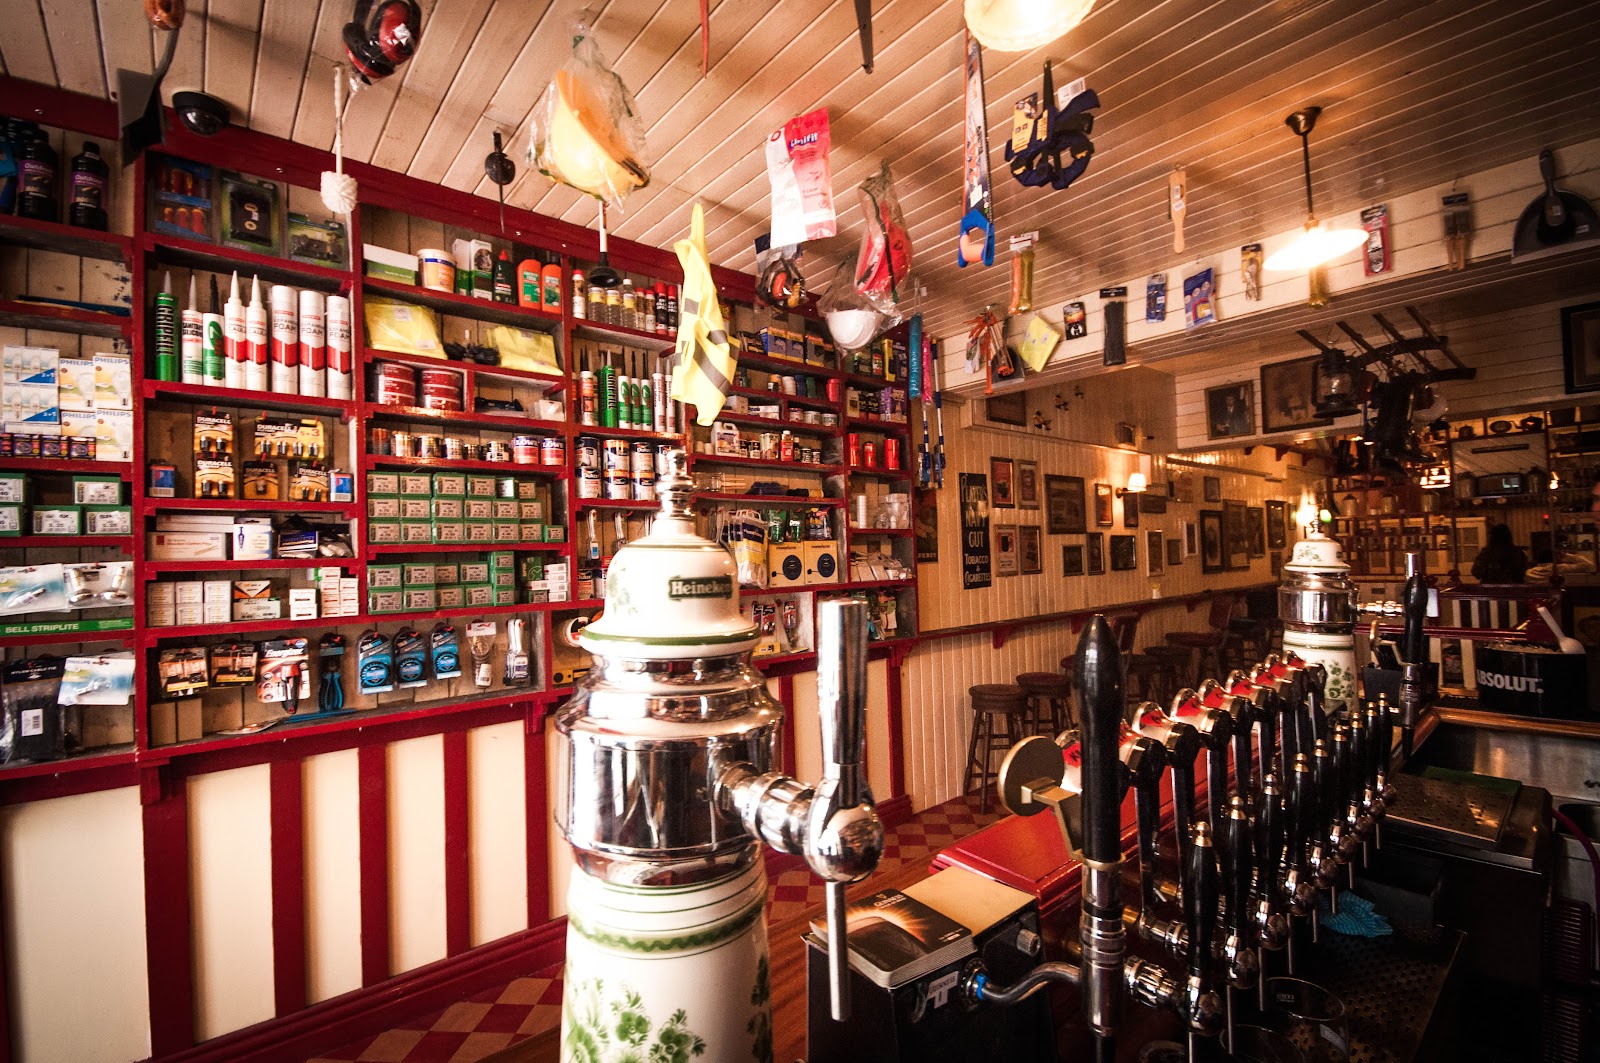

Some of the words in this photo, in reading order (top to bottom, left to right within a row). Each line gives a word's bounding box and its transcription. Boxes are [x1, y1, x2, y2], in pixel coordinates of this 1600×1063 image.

[790, 131, 819, 148] Unifit
[274, 323, 296, 331] FOAM
[301, 327, 324, 336] FOAM
[94, 357, 129, 365] PHILIPS
[197, 416, 232, 425] DURACELL
[197, 459, 233, 468] DURACELL
[299, 467, 328, 476] DURACELL
[968, 531, 984, 548] CUT
[964, 554, 989, 565] TOBACCO
[671, 581, 731, 595] Heineken
[5, 626, 30, 634] BELL
[31, 623, 79, 632] STRIPLITE
[265, 648, 304, 658] Energizer
